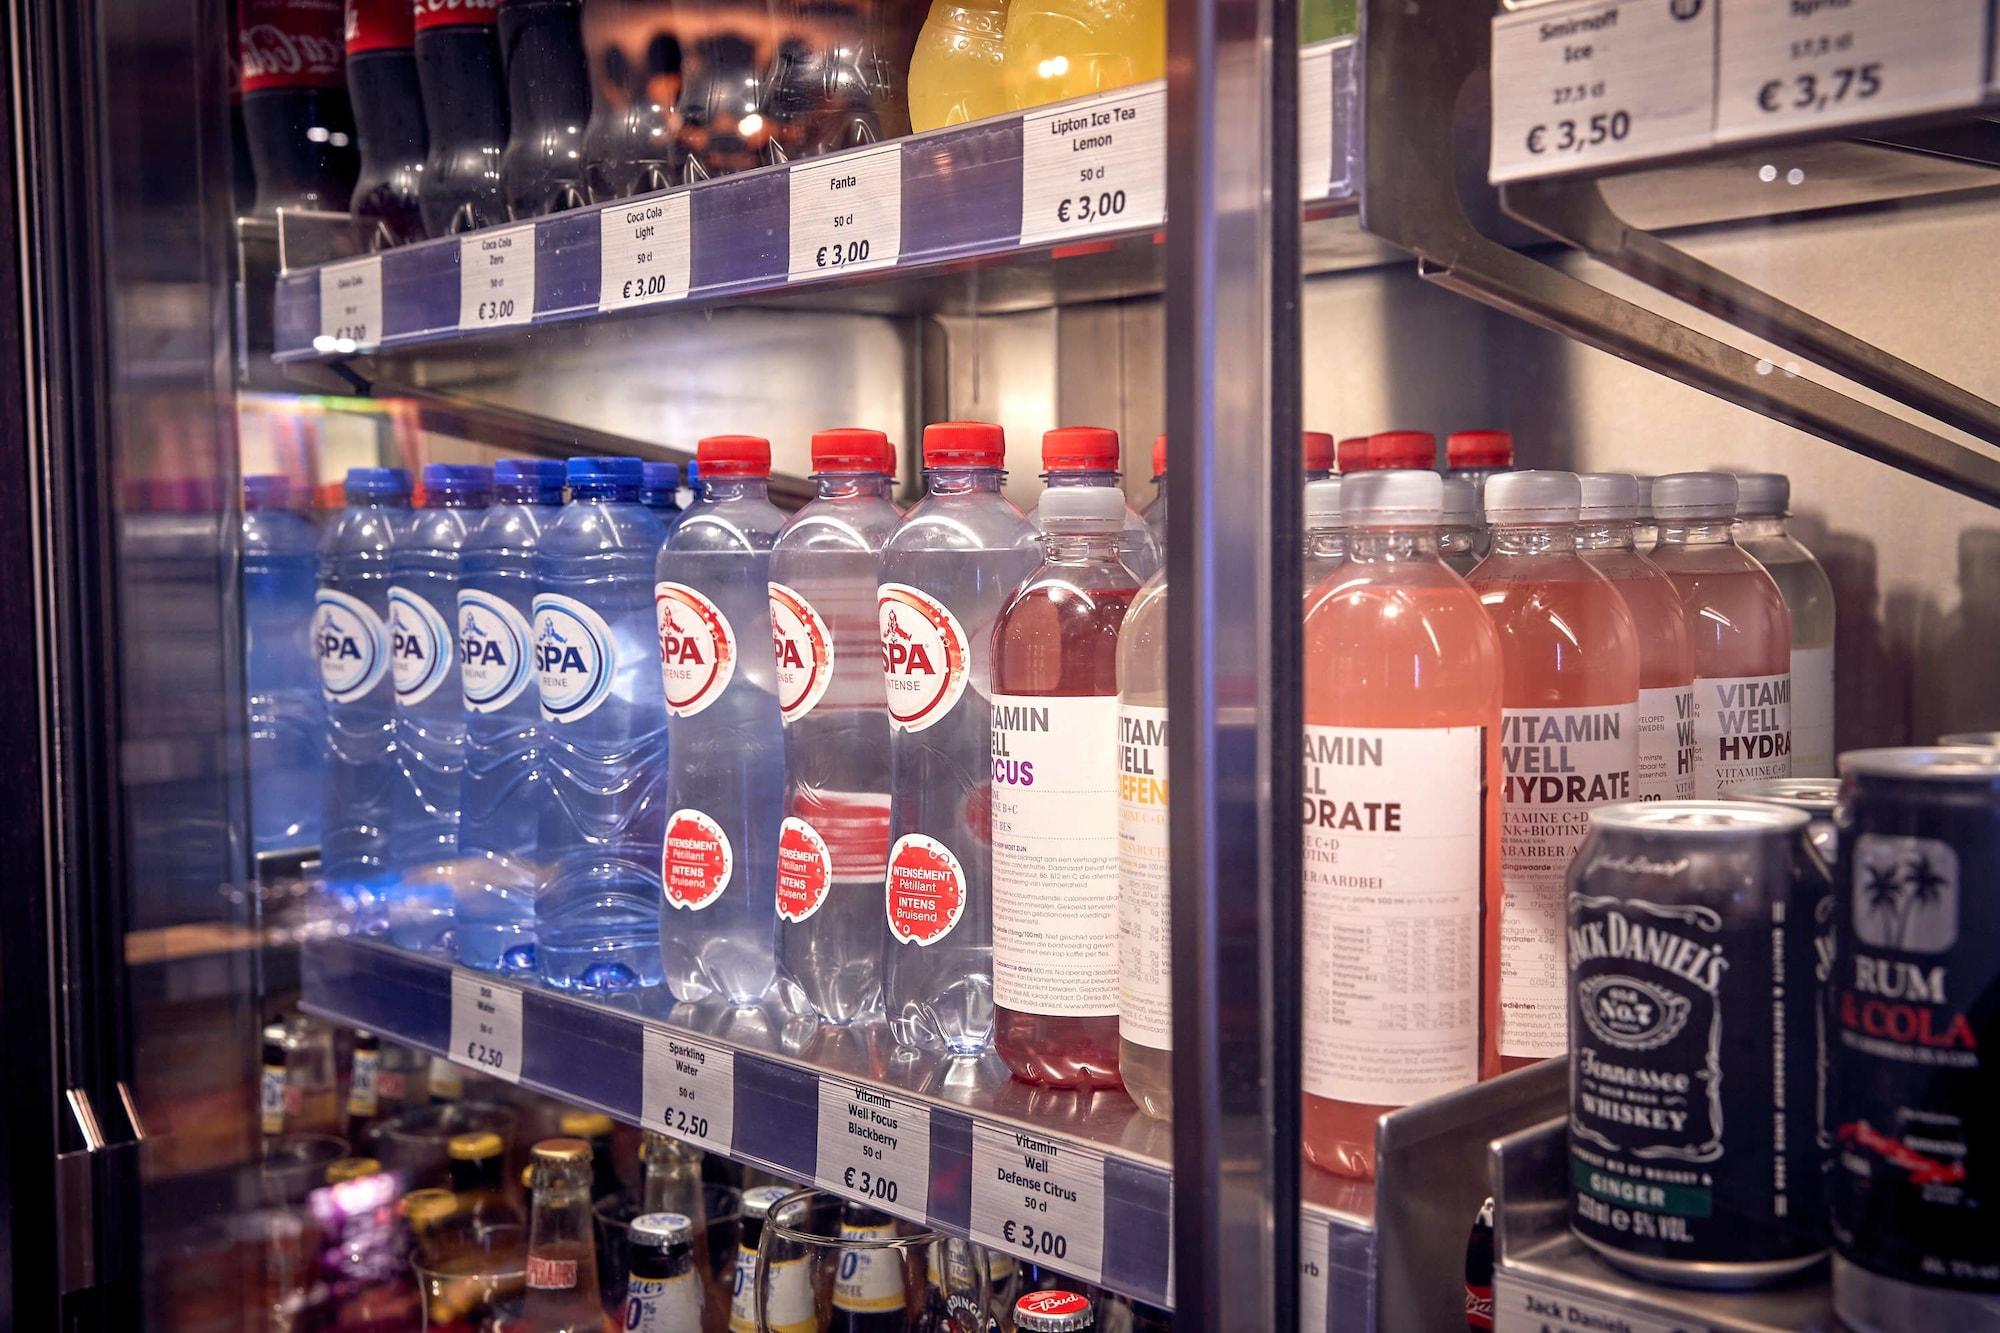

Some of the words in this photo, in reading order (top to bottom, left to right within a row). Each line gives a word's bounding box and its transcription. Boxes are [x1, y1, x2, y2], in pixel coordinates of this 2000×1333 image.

[1539, 9, 1619, 43] Smirnoff
[1564, 43, 1594, 64] Ice
[1757, 80, 1783, 113] €
[1793, 63, 1882, 111] 3,75
[1051, 118, 1088, 136] Lipton
[1091, 112, 1110, 127] Ice
[1113, 107, 1136, 122] Tea
[1526, 126, 1547, 154] €
[1556, 109, 1631, 153] 3,50
[1072, 134, 1113, 152] Lemon
[830, 176, 856, 190] Fanta
[1080, 168, 1093, 182] 50
[1096, 166, 1105, 179] cl
[627, 211, 644, 224] Coca
[646, 206, 662, 219] Cola
[1057, 199, 1072, 223] €
[1078, 190, 1126, 223] 3,00
[834, 216, 844, 228] 50
[846, 214, 853, 225] cl
[635, 225, 654, 240] Light
[482, 240, 496, 251] Coca
[498, 237, 512, 248] Cola
[816, 247, 827, 267] €
[832, 239, 870, 265] 3,00
[489, 254, 504, 265] Zero
[637, 253, 645, 264] 50
[646, 252, 652, 262] cl
[623, 280, 632, 298] €
[635, 275, 665, 297] 3,00
[478, 303, 487, 320] €
[488, 300, 514, 320] 3,00
[536, 646, 588, 673] SPA
[1718, 708, 1779, 734] WELL
[1303, 733, 1383, 767] AMIN
[1716, 766, 1770, 778] VITAMINE
[1563, 811, 1589, 823] C+D
[1315, 836, 1339, 850] C+D
[672, 849, 705, 861] Pétillant
[672, 865, 704, 877] INTENS
[893, 865, 952, 882] INTENSÉMENT
[670, 875, 706, 888] Bruisend
[780, 876, 806, 890] INTENS
[899, 878, 937, 892] Pétillant
[779, 886, 807, 900] Bruisend
[898, 897, 936, 910] INTENS
[896, 908, 938, 922] Bruisend
[1607, 911, 1731, 993] DANIEL'S
[1855, 954, 1948, 1004] RUM
[1862, 1000, 1978, 1048] COLA
[468, 1045, 476, 1060] €
[478, 1045, 503, 1069] 2,50
[669, 1042, 705, 1065] Sparkling
[675, 1059, 698, 1078] Water
[1581, 1047, 1690, 1093] Tennessee
[679, 1087, 688, 1099] 50
[689, 1090, 695, 1101] cl
[854, 1087, 891, 1109] Vitamin
[848, 1103, 869, 1120] Well
[871, 1110, 898, 1129] Focus
[1581, 1092, 1688, 1133] WHISKEY
[664, 1107, 674, 1127] €
[677, 1111, 708, 1139] 2,50
[848, 1121, 898, 1151] Blackberry
[1015, 1133, 1058, 1157] Vitamin
[862, 1146, 873, 1159] 50
[875, 1149, 882, 1161] cl
[1024, 1155, 1049, 1174] Well
[844, 1167, 856, 1189] €
[859, 1172, 898, 1203] 3,00
[997, 1167, 1042, 1192] Defense
[1043, 1180, 1077, 1202] Citrus
[1590, 1172, 1665, 1208] GINGER
[1024, 1196, 1037, 1210] 50
[1038, 1199, 1047, 1213] cl
[1003, 1220, 1016, 1244] €
[1021, 1226, 1067, 1259] 3,00
[1028, 1294, 1079, 1312] Bud
[1525, 1295, 1562, 1318] Jack
